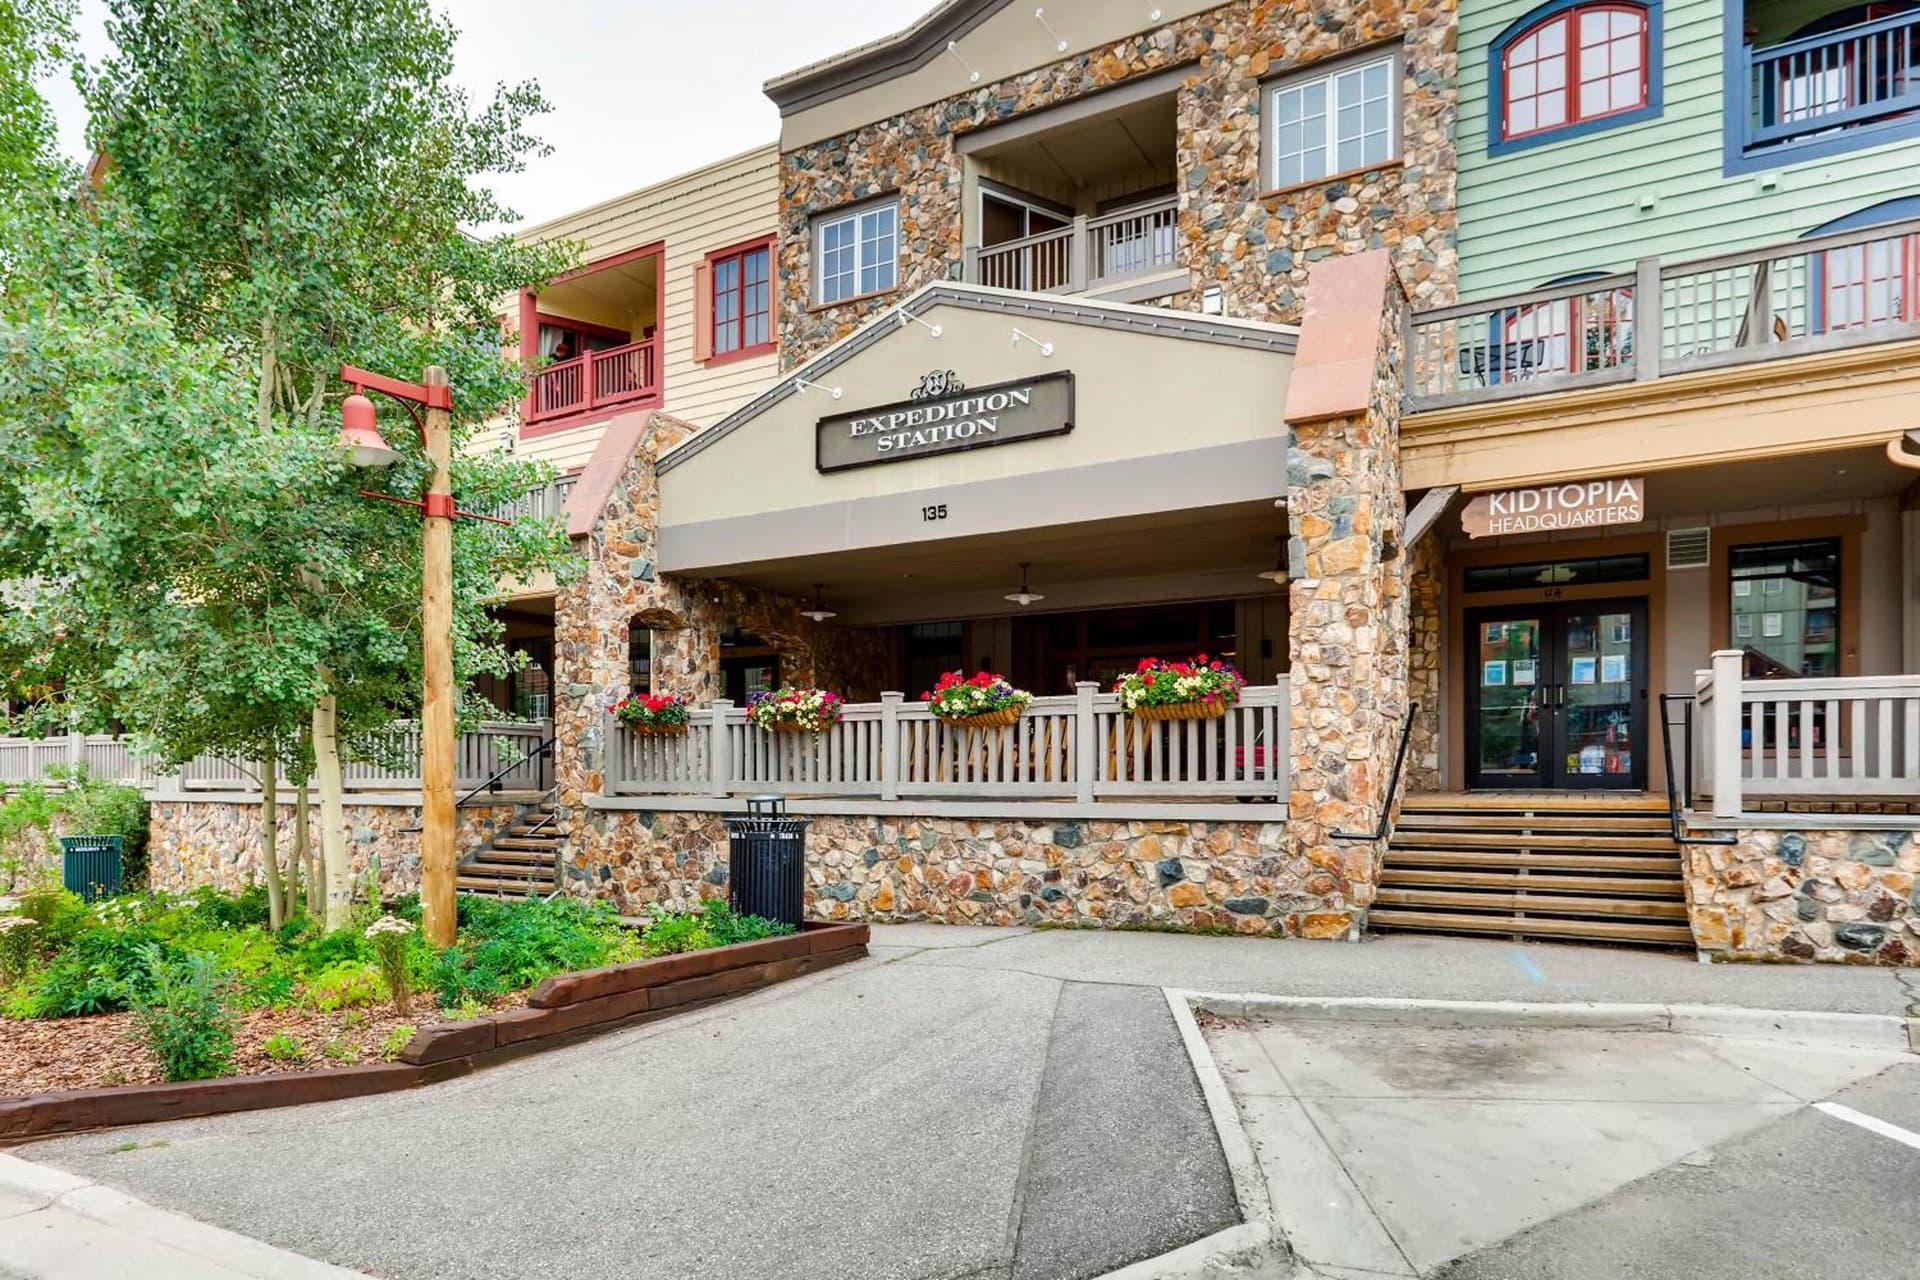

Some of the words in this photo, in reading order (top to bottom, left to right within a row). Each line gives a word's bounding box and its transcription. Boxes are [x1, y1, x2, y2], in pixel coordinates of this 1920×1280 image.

[850, 387, 1032, 437] EXPEDITION
[877, 416, 998, 452] STATION
[922, 504, 947, 522] 135
[1488, 478, 1639, 516] KIDTOPIA
[1488, 504, 1640, 534] HEADQUARTERS
